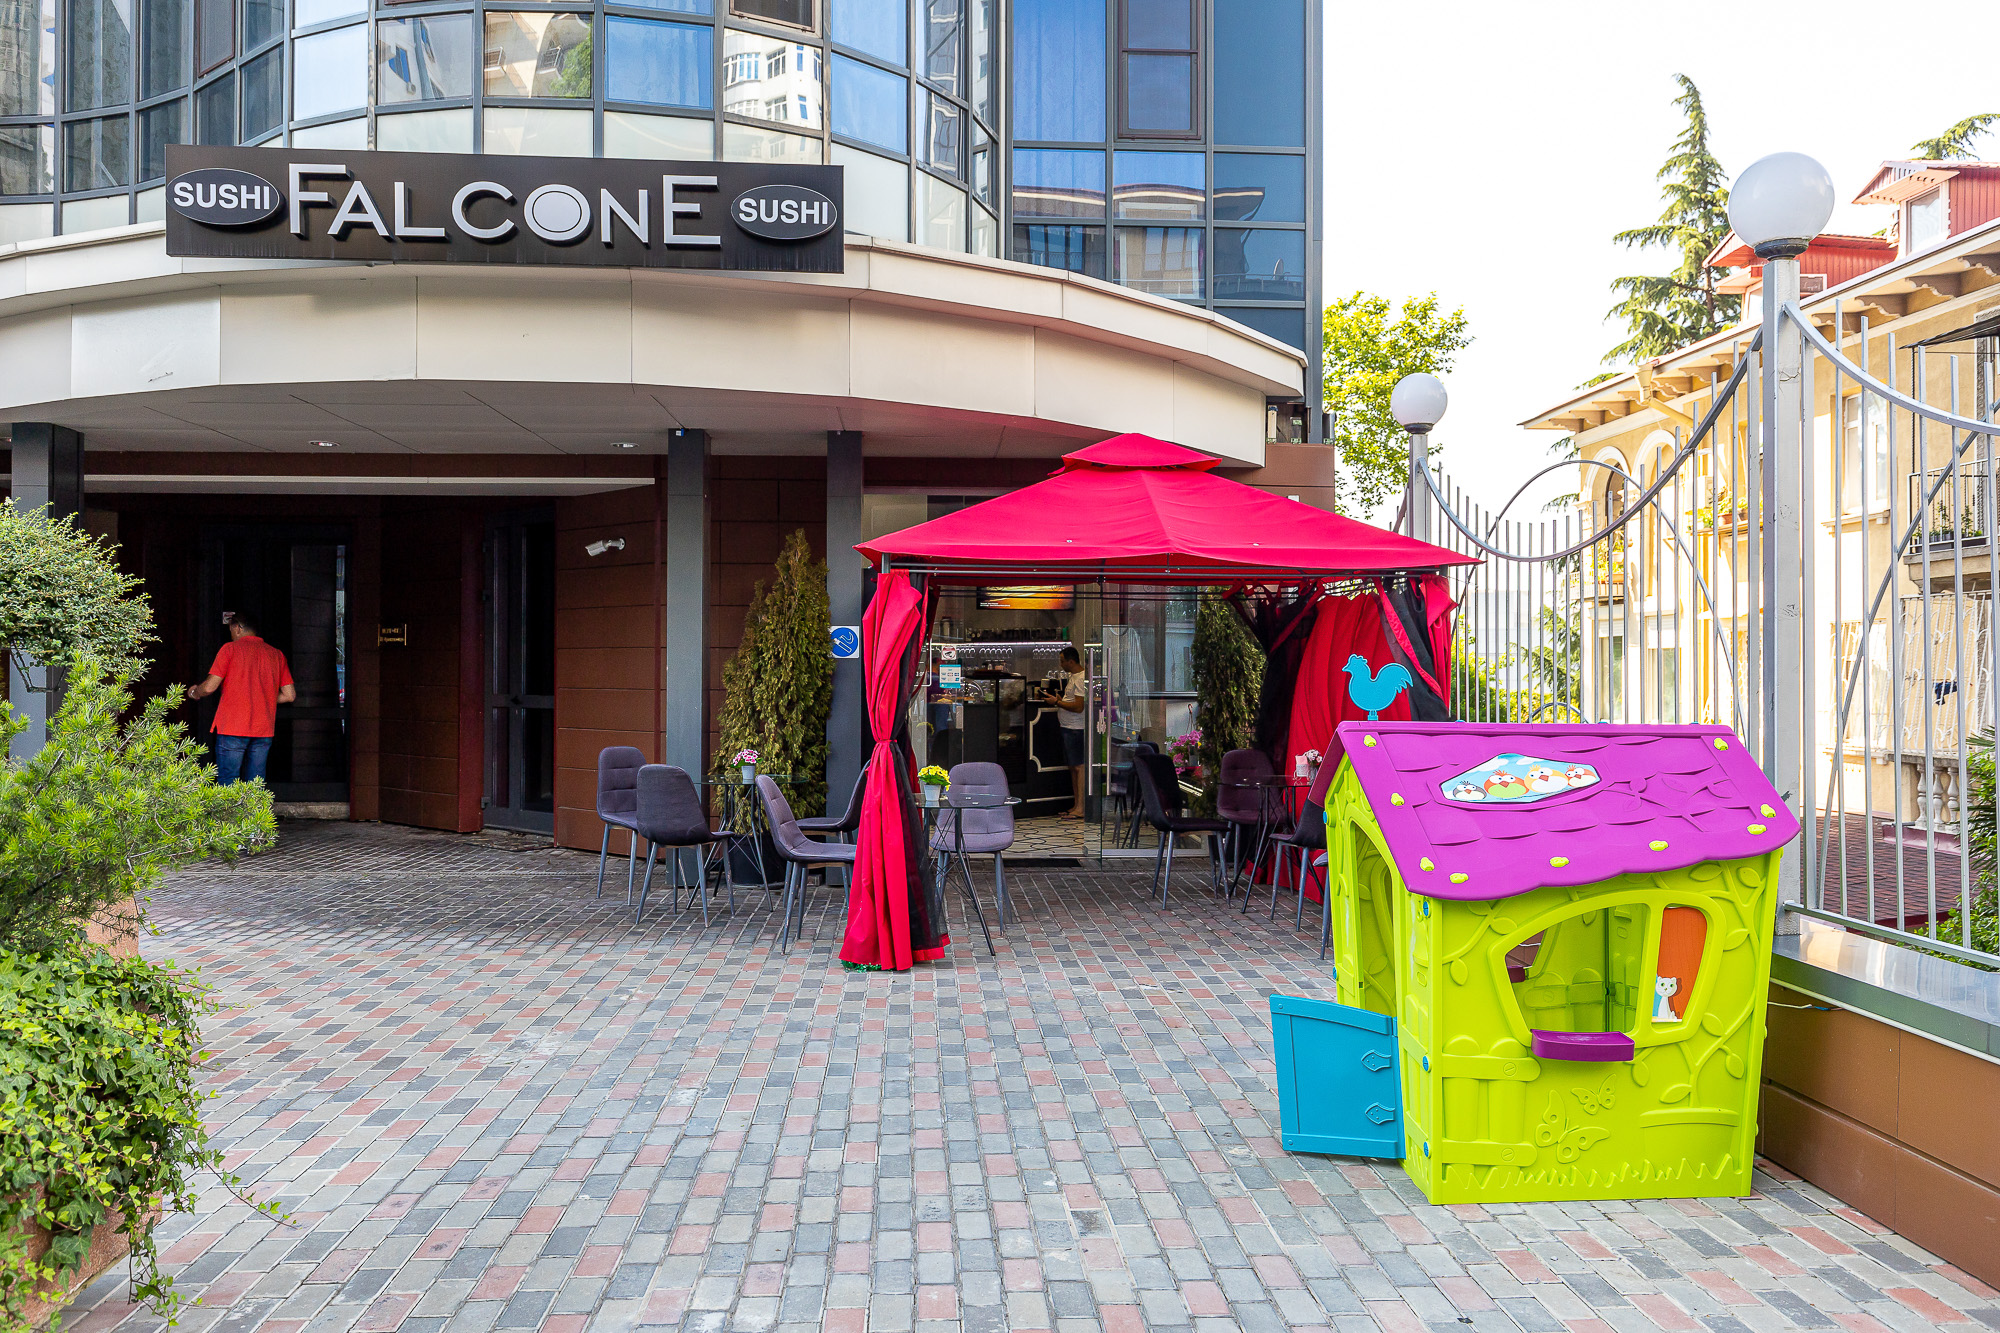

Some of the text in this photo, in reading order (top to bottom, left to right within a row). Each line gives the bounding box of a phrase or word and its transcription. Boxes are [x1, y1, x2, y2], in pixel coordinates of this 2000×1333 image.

[173, 181, 270, 210] SUSHI
[289, 163, 721, 245] FALCONE
[738, 199, 829, 225] SUSHI
